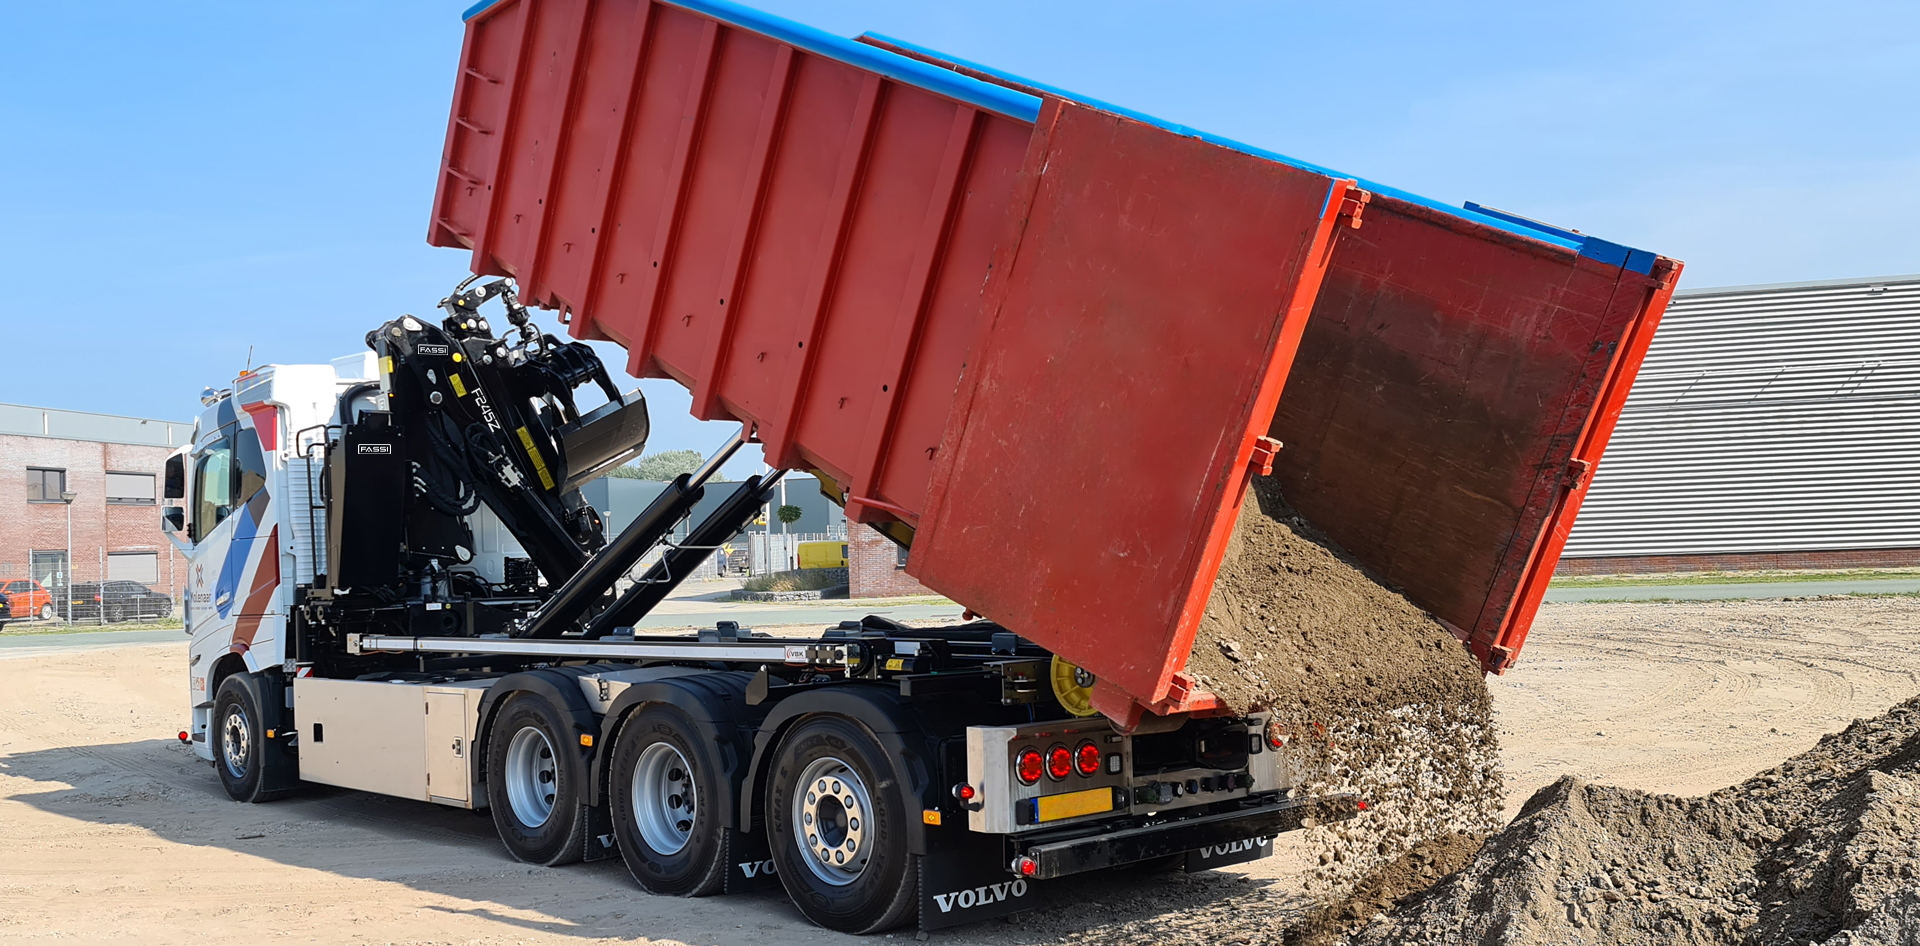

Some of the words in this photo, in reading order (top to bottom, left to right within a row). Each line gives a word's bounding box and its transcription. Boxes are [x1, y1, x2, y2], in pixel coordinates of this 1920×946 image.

[419, 346, 447, 354] FASSI
[471, 387, 501, 433] F245Z
[774, 785, 783, 833] KMAX
[1200, 836, 1268, 859] VOLVO
[933, 879, 1028, 913] VOLVO
